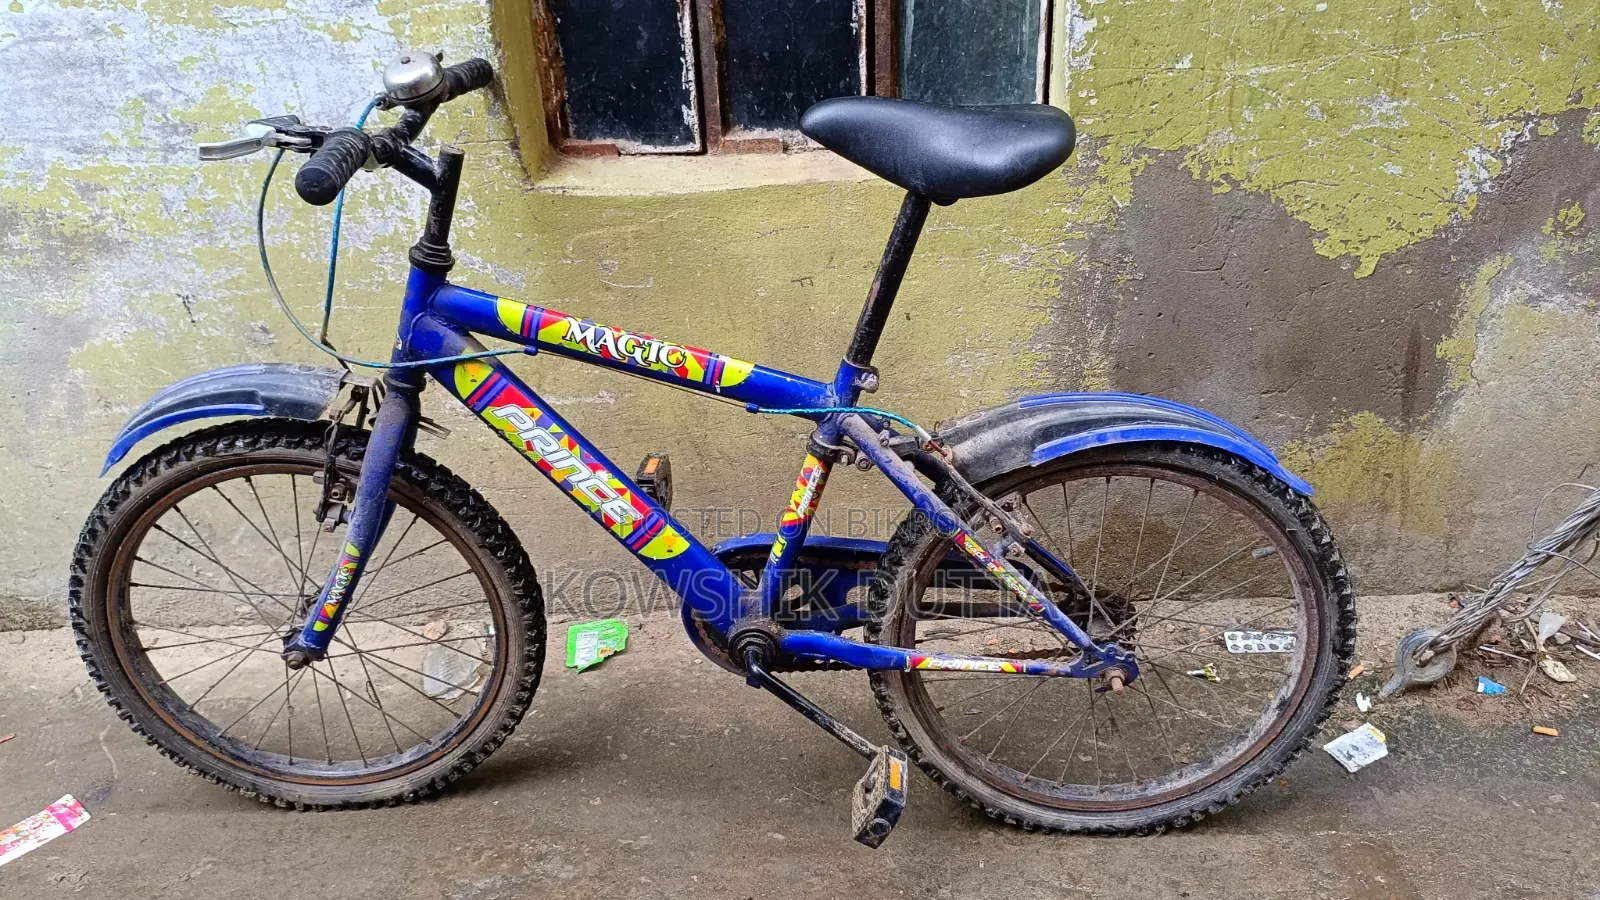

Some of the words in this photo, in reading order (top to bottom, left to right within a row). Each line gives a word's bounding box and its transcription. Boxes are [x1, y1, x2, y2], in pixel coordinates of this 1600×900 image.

[562, 316, 687, 368] MAGIC
[489, 404, 644, 525] PRINCE
[797, 465, 821, 519] PRINCE
[325, 566, 351, 606] MAGIC
[928, 658, 1003, 671] PRINCE
